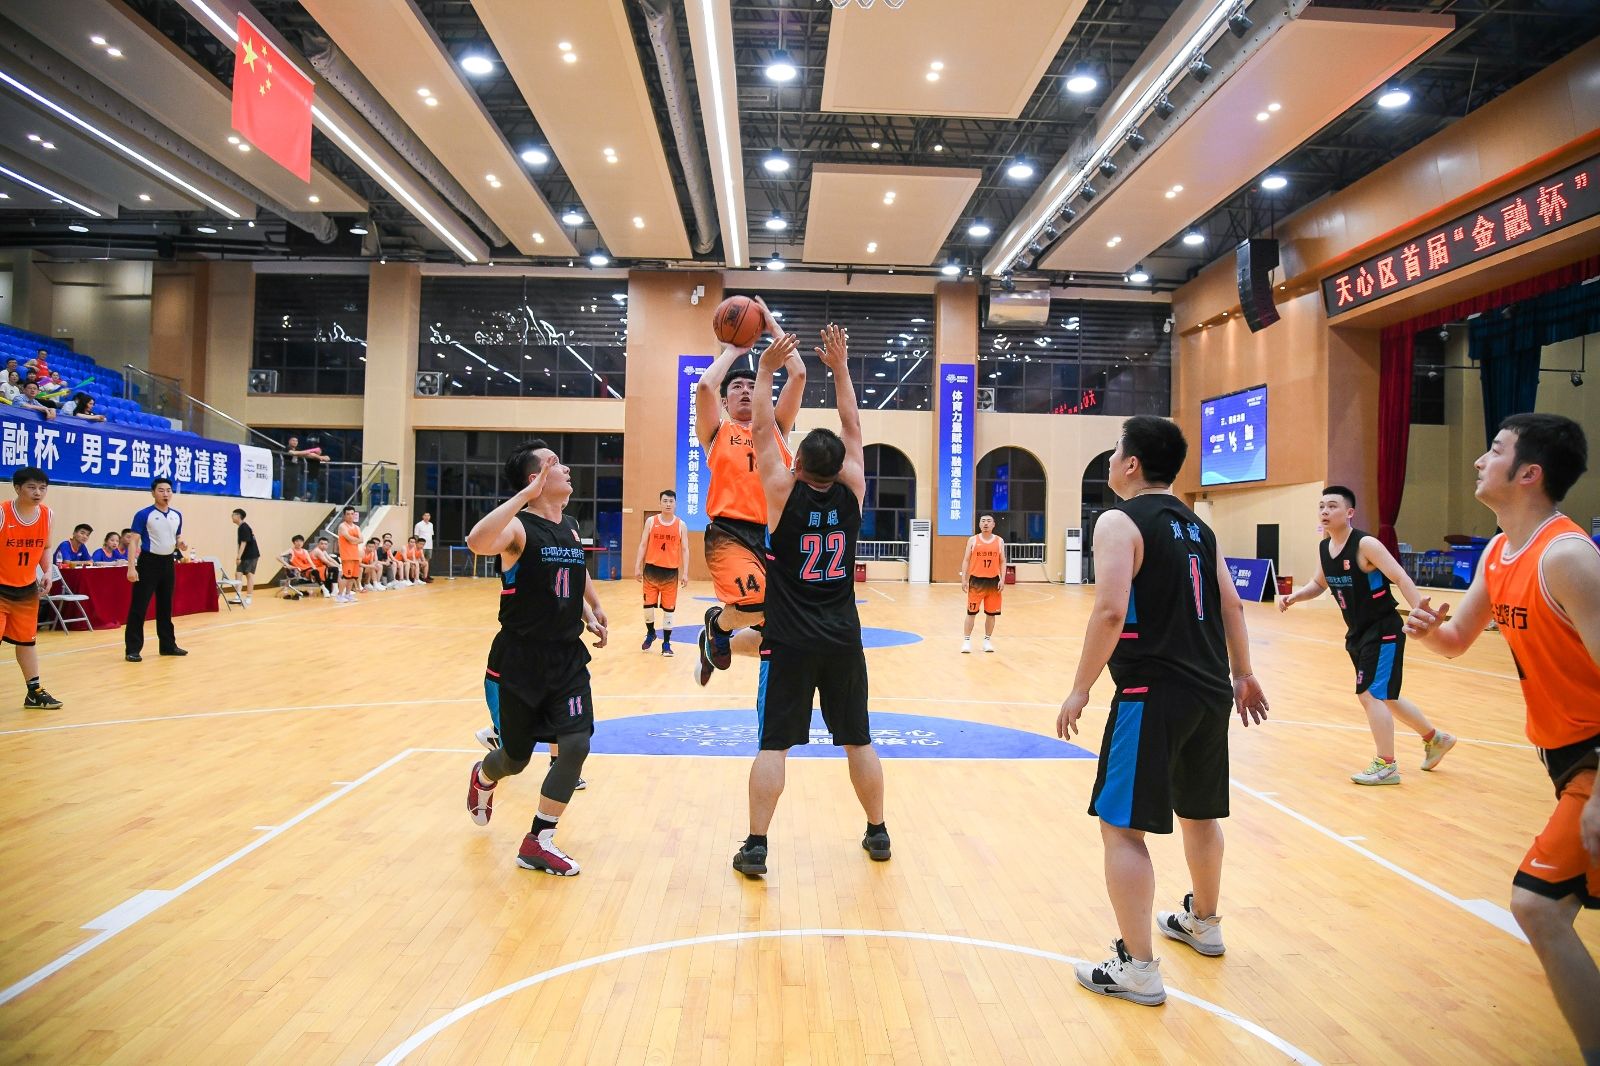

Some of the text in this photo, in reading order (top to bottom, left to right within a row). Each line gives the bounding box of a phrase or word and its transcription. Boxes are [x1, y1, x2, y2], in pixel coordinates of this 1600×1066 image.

[1336, 172, 1588, 307] 天心区首届“金融杯”
[660, 542, 666, 552] 4
[800, 531, 846, 581] 22
[18, 551, 30, 567] 11
[983, 559, 992, 569] 17
[734, 572, 761, 598] 14
[1188, 554, 1204, 621] 1
[1337, 589, 1347, 610] 5
[1356, 670, 1364, 685] 5
[568, 695, 583, 717] 11
